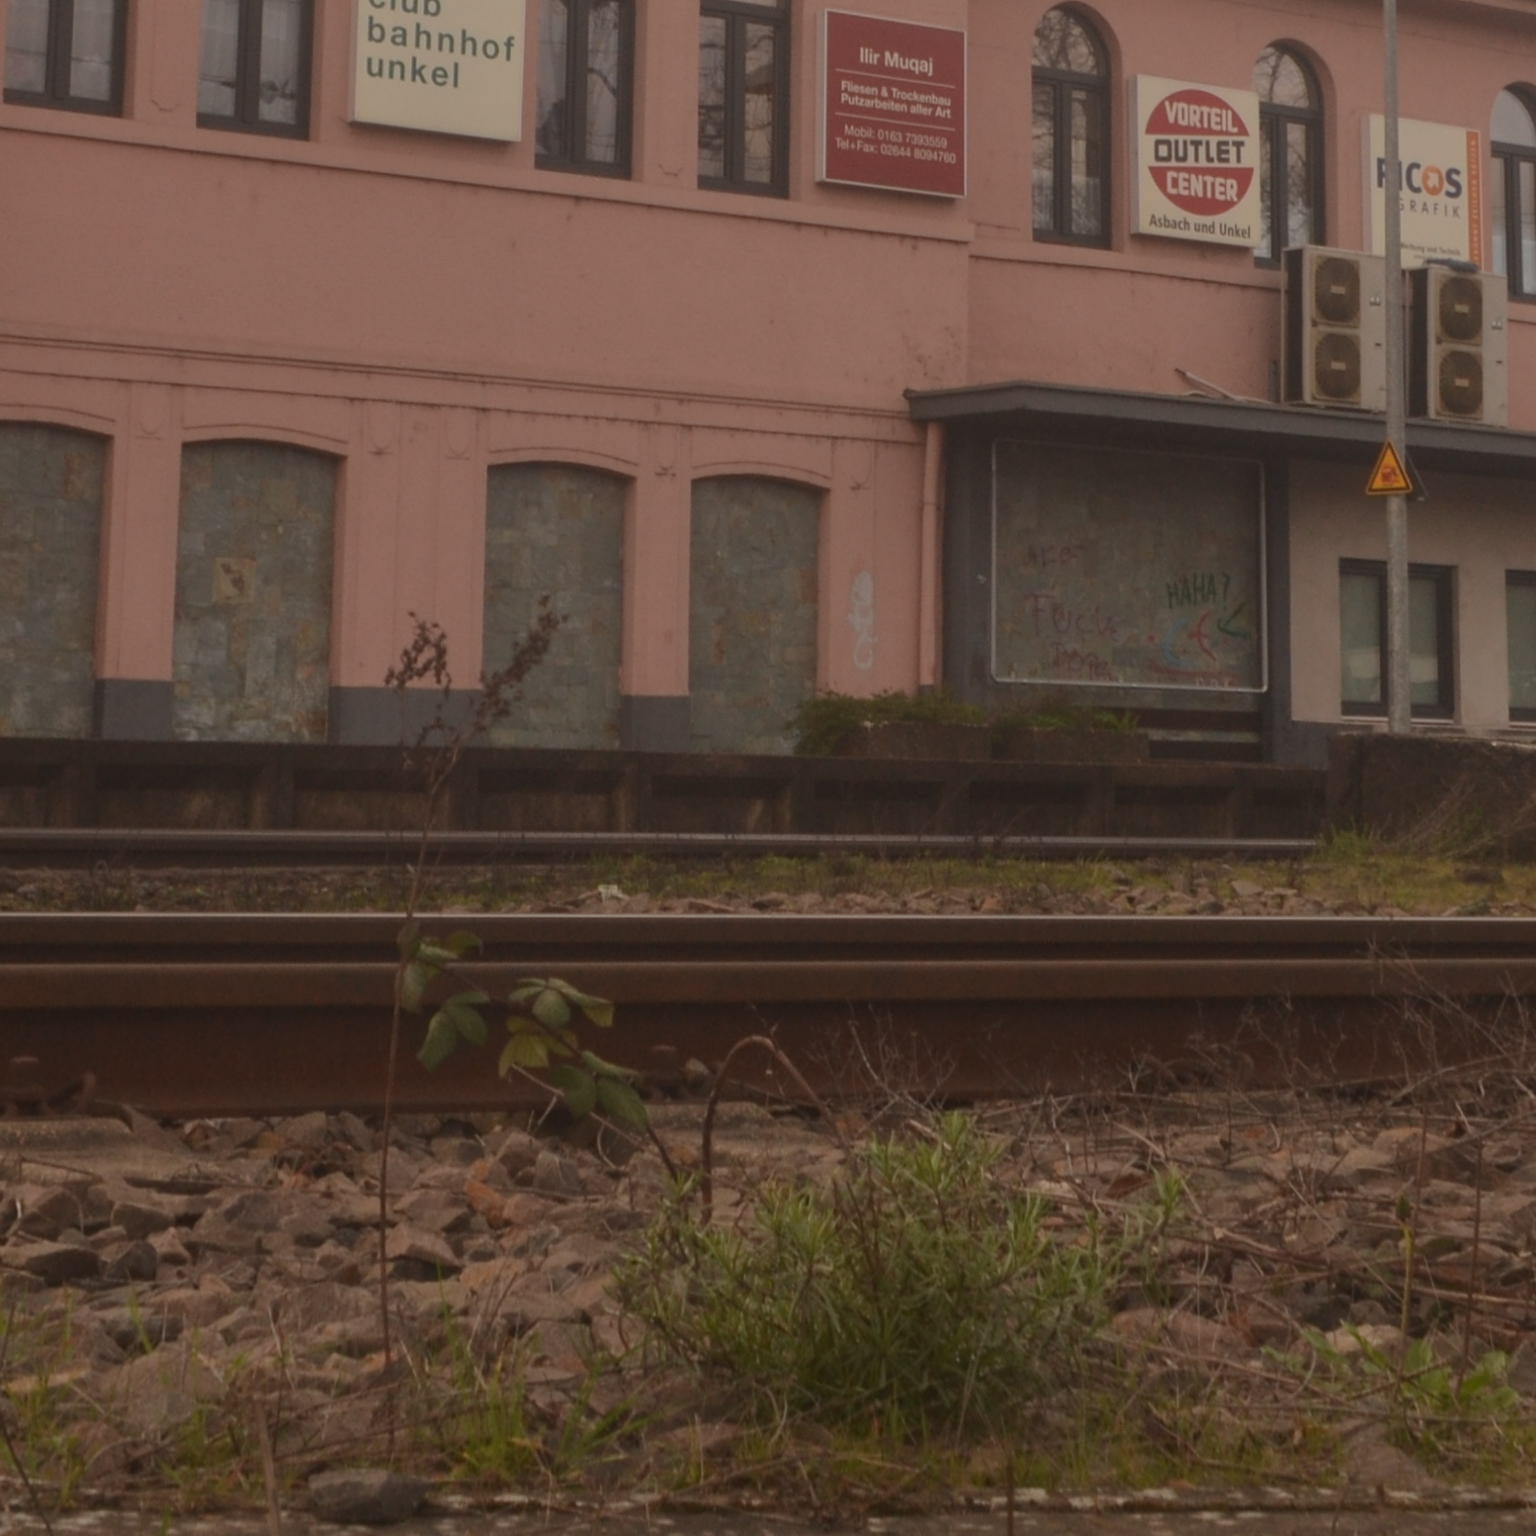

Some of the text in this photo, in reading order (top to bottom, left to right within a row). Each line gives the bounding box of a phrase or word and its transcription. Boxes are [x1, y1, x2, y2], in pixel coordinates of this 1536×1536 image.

[367, 15, 515, 62] bahnhof
[366, 56, 459, 88] unkel
[884, 51, 934, 77] Muqaj
[840, 80, 952, 107] Fliesen & Trockenbau
[840, 93, 952, 119] Putzarbeiten aller Art
[1164, 100, 1238, 133] VORTEIL
[844, 124, 874, 139] Mobil:
[877, 128, 903, 142] 0163
[1154, 139, 1245, 163] OUTLET
[1166, 170, 1238, 202] CENTER
[1149, 214, 1251, 239] Asbach und Unkel
